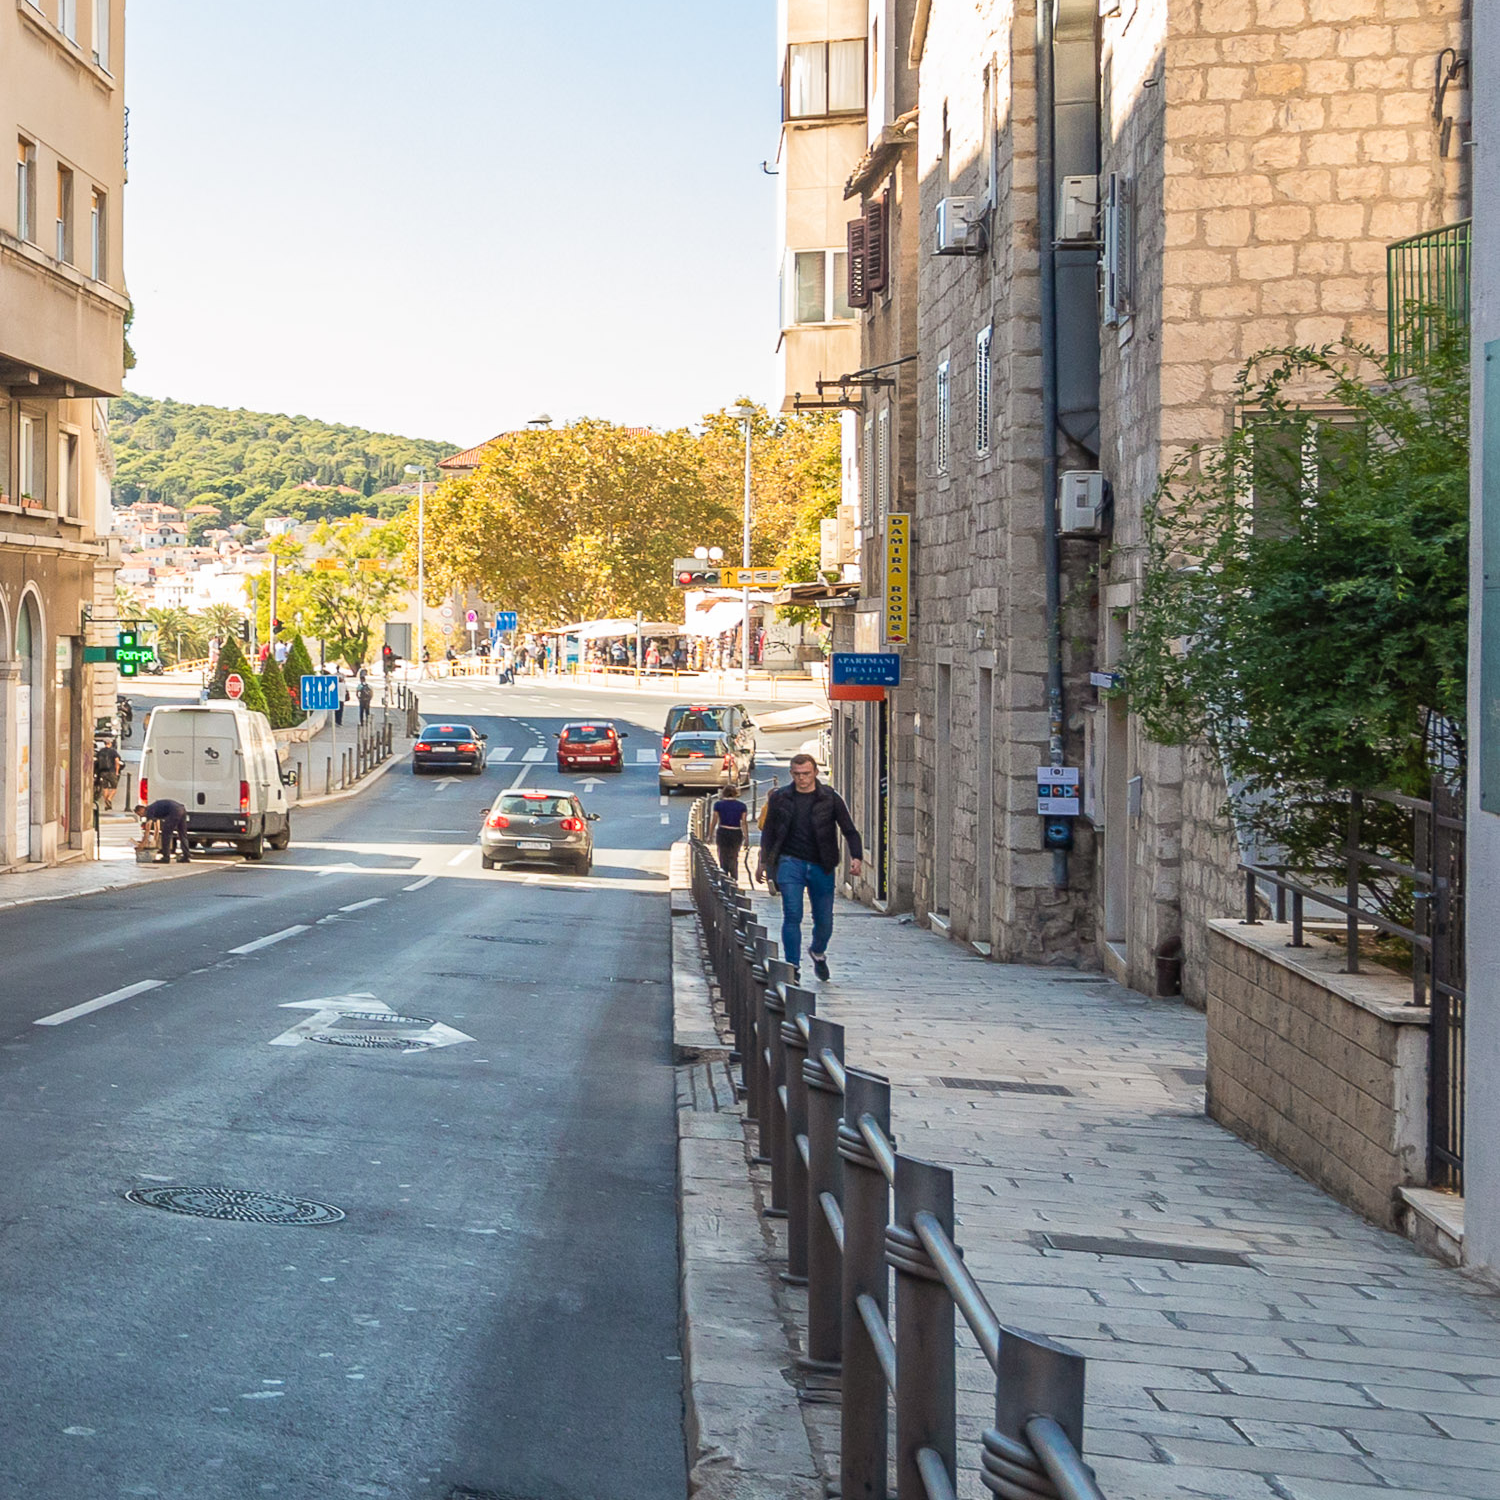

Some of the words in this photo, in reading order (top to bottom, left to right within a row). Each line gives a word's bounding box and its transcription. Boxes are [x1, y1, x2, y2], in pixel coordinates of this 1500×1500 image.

[890, 518, 904, 574] DAMIRA
[889, 585, 903, 632] ROOMS
[836, 657, 895, 665] APARTMANI
[845, 666, 866, 674] DEA
[227, 682, 241, 692] STOP
